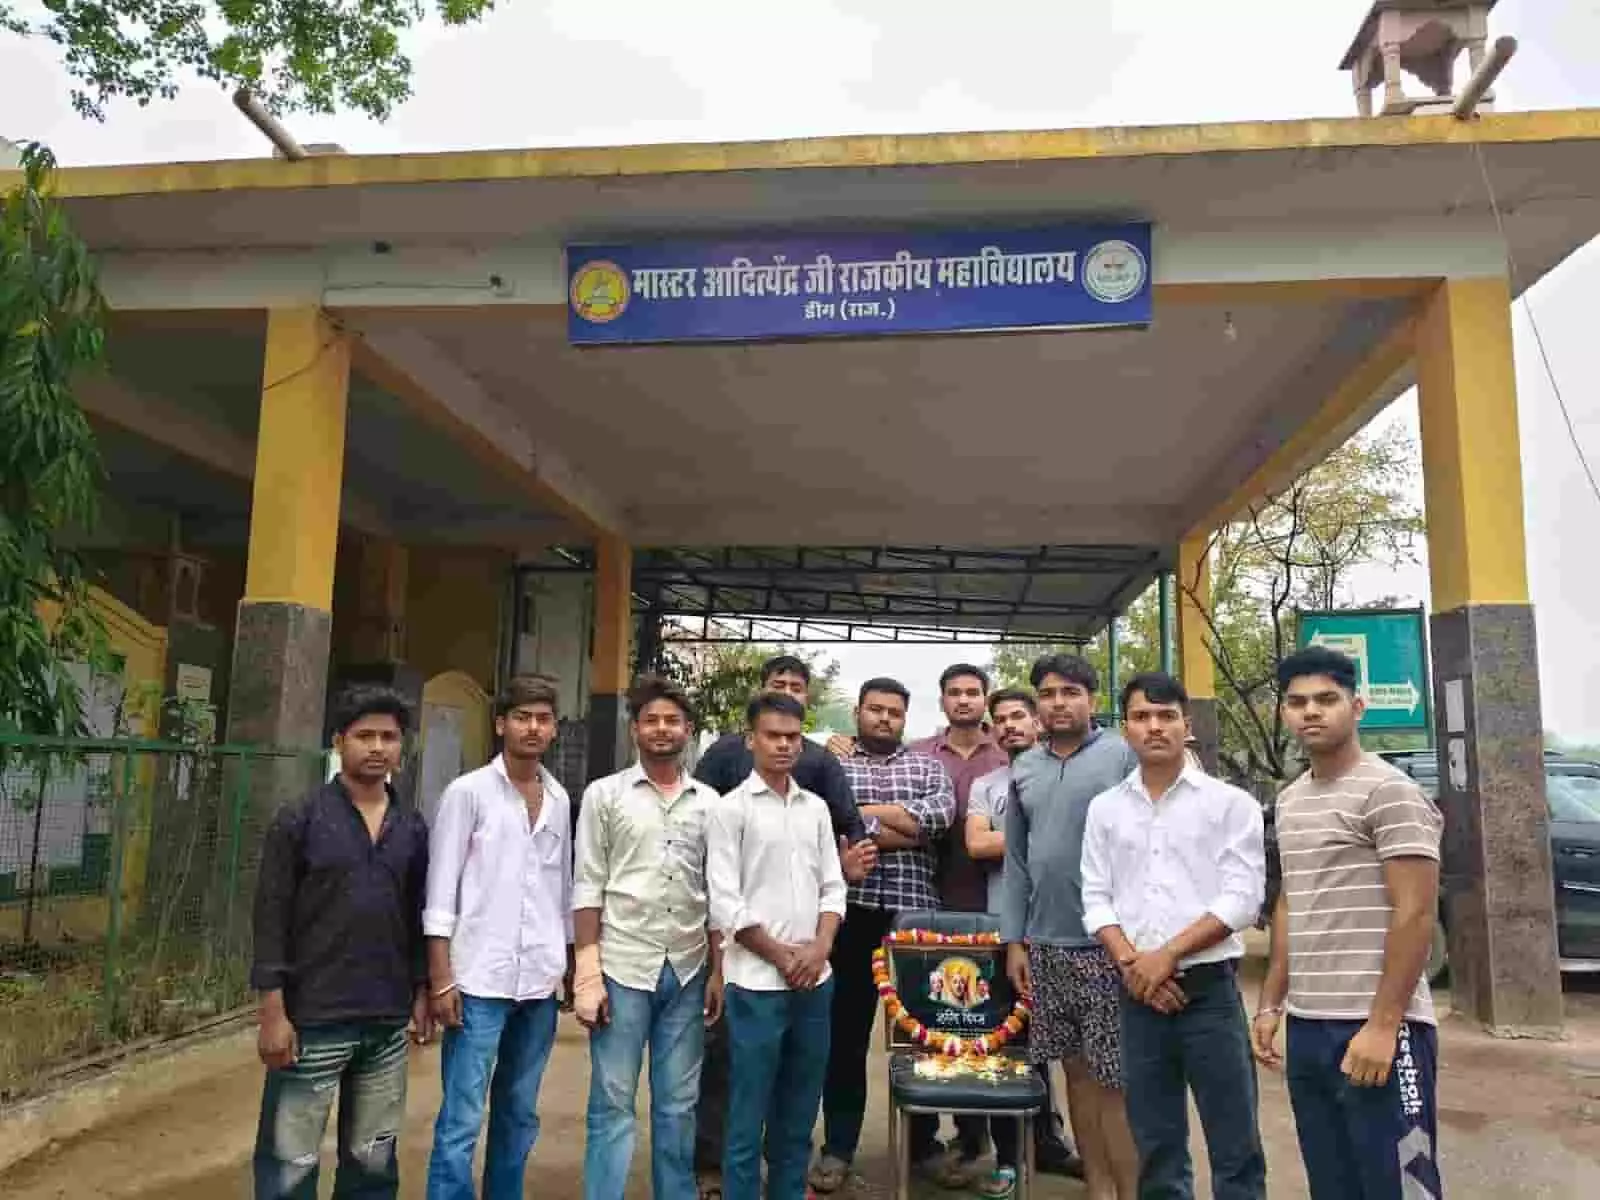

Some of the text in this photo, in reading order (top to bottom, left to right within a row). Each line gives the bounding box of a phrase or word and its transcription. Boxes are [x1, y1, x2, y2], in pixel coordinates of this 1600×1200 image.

[632, 268, 697, 299] मास्टर
[703, 255, 799, 297] आदित्येंद्र
[803, 253, 833, 293] जी
[838, 250, 932, 293] राजकीय
[936, 245, 1076, 288] महाविद्यालय
[803, 297, 895, 320] डीग (राज.)
